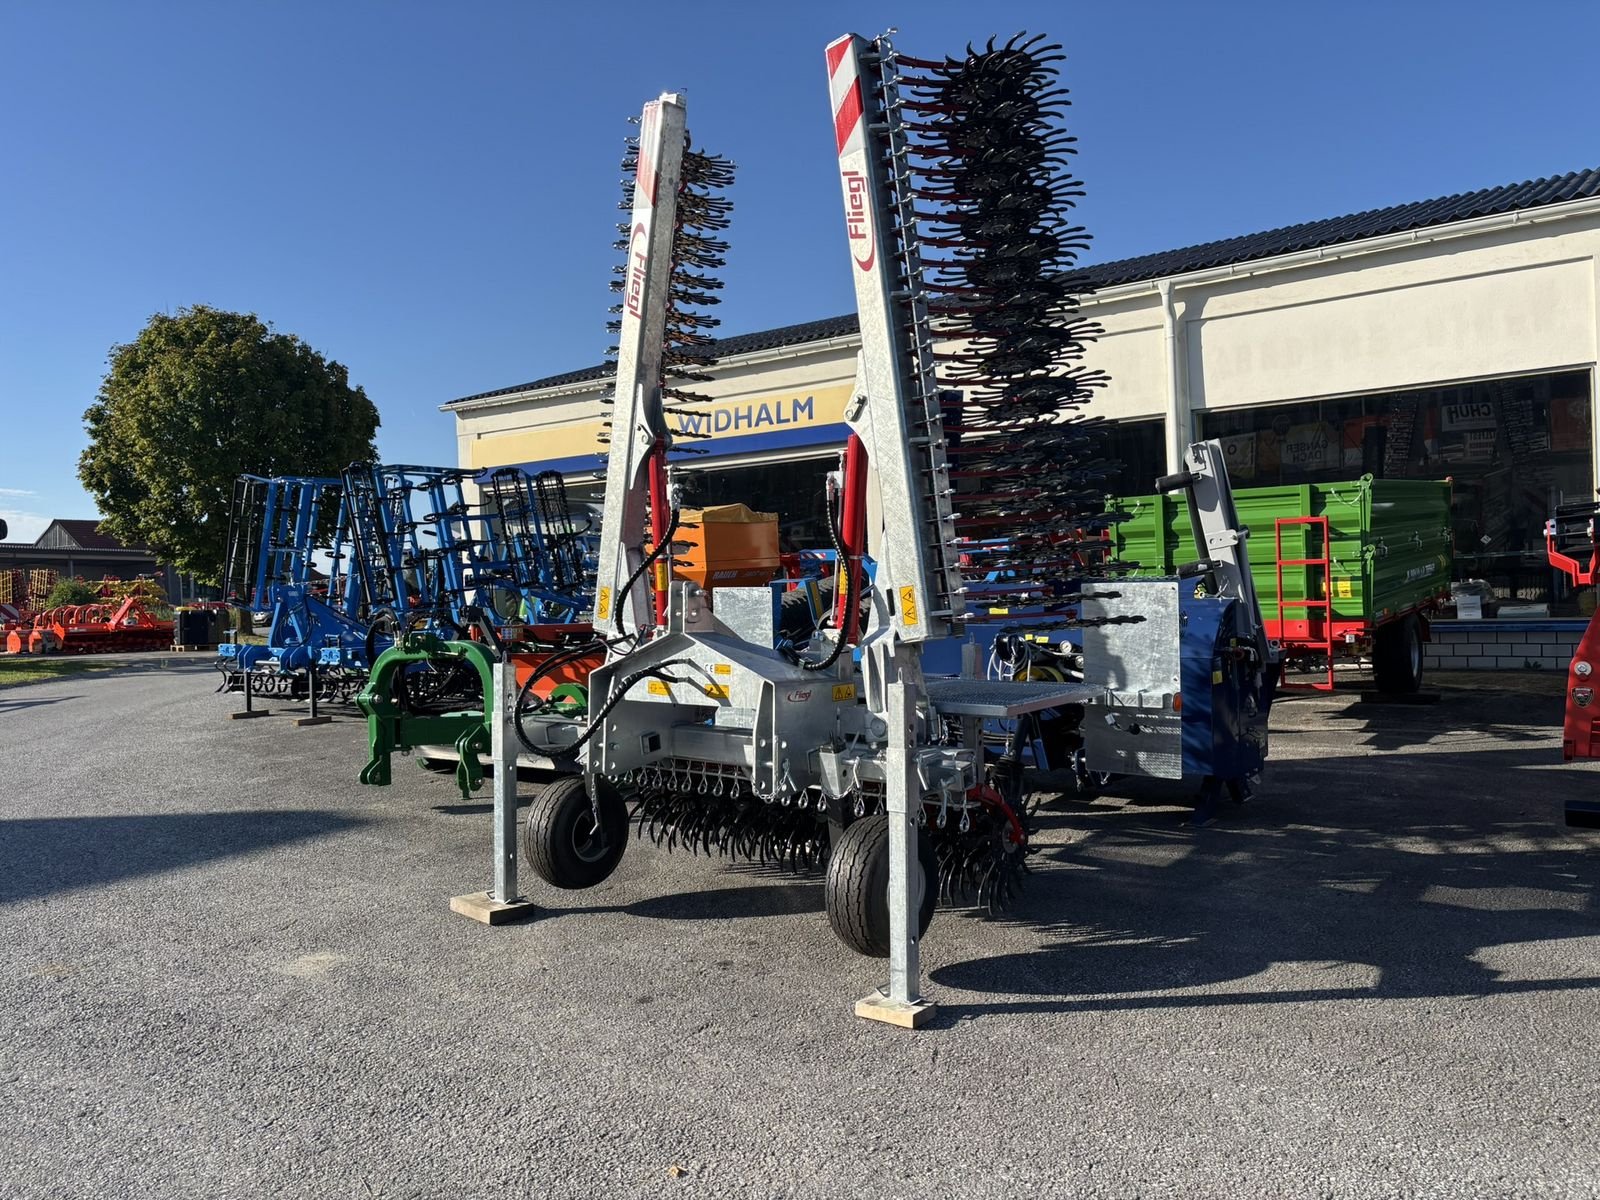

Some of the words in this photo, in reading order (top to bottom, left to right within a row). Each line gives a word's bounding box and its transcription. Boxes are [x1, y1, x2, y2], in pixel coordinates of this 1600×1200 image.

[842, 171, 867, 239] Fliegl
[625, 251, 650, 320] Fliegl
[677, 396, 814, 434] WIDHALM
